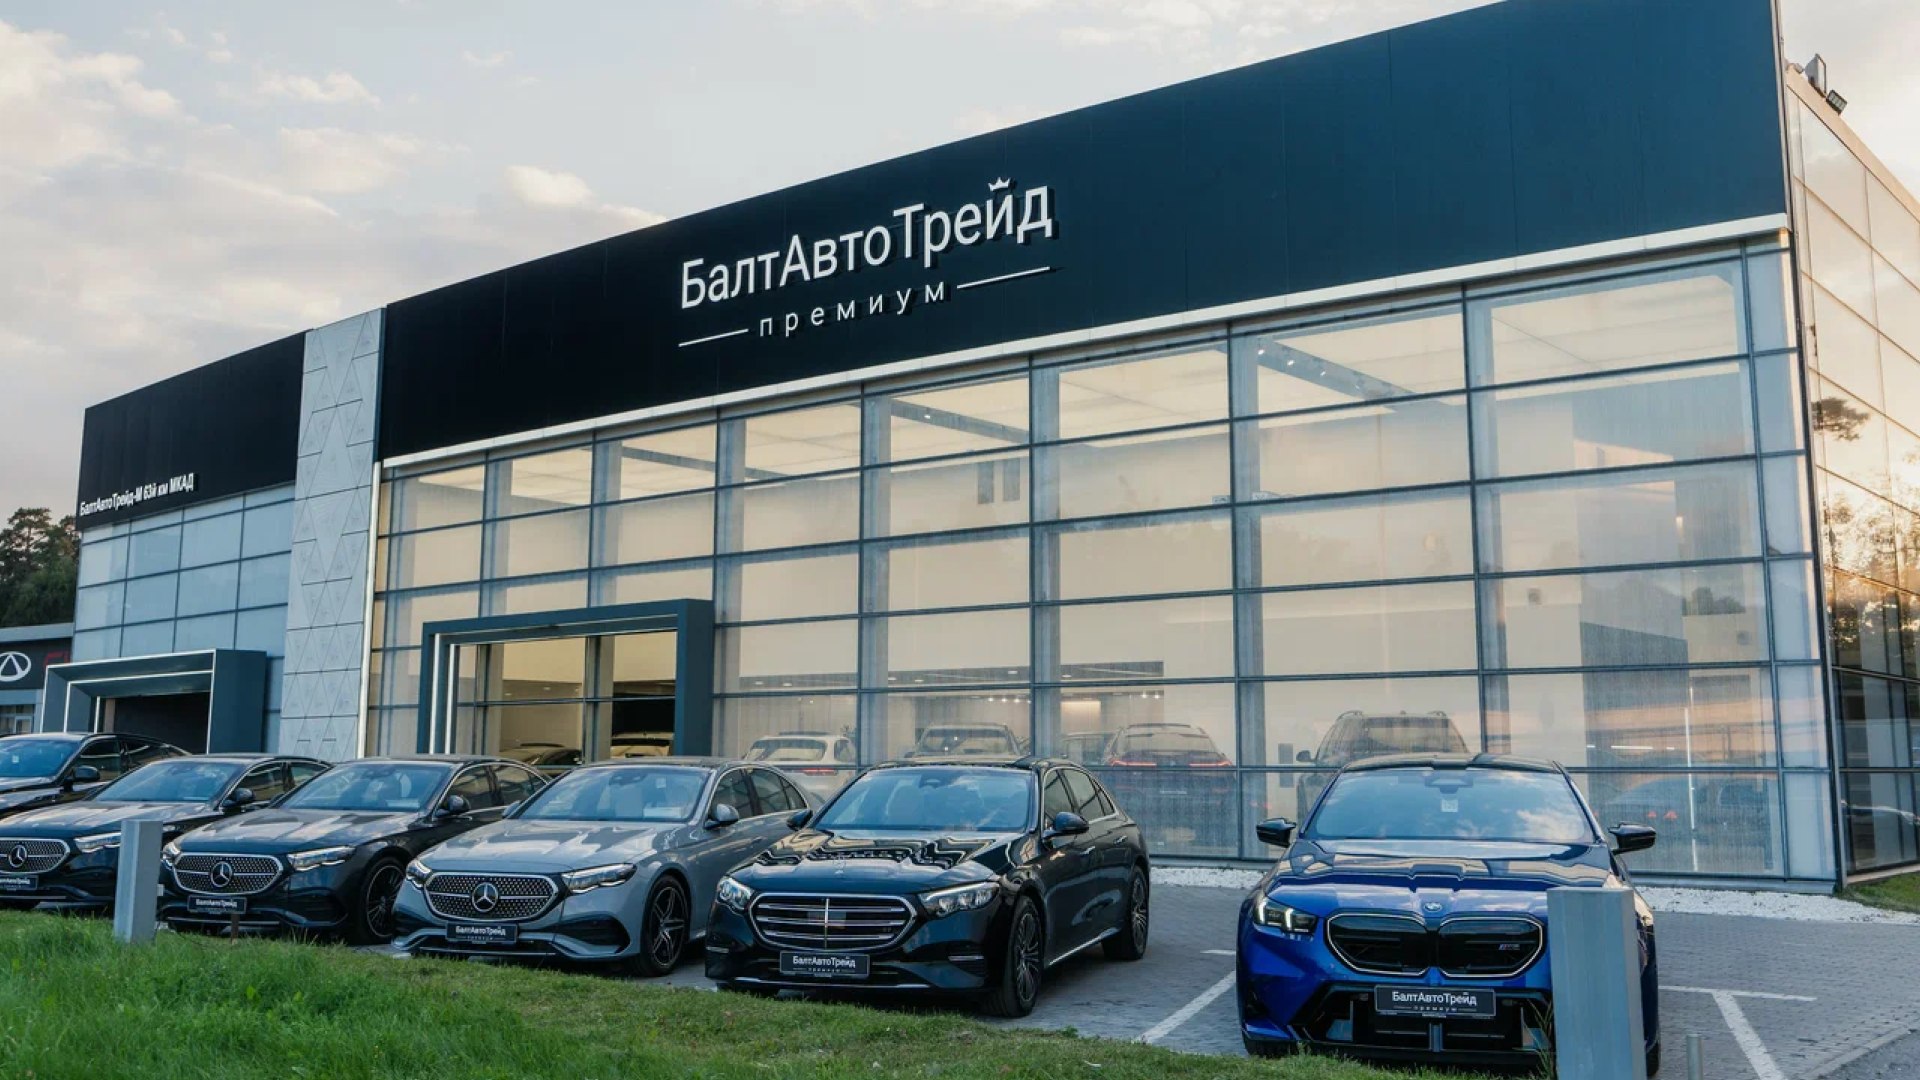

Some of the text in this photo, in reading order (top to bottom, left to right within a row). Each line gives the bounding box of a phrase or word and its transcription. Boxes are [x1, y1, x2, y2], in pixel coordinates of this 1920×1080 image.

[681, 177, 1053, 309] БалтАвтоТрейд
[759, 281, 945, 337] премиум
[169, 472, 194, 493] МКАД
[792, 955, 856, 968] БалтАвтоТрейд
[1391, 991, 1477, 1006] БалтАвтоТрейд
